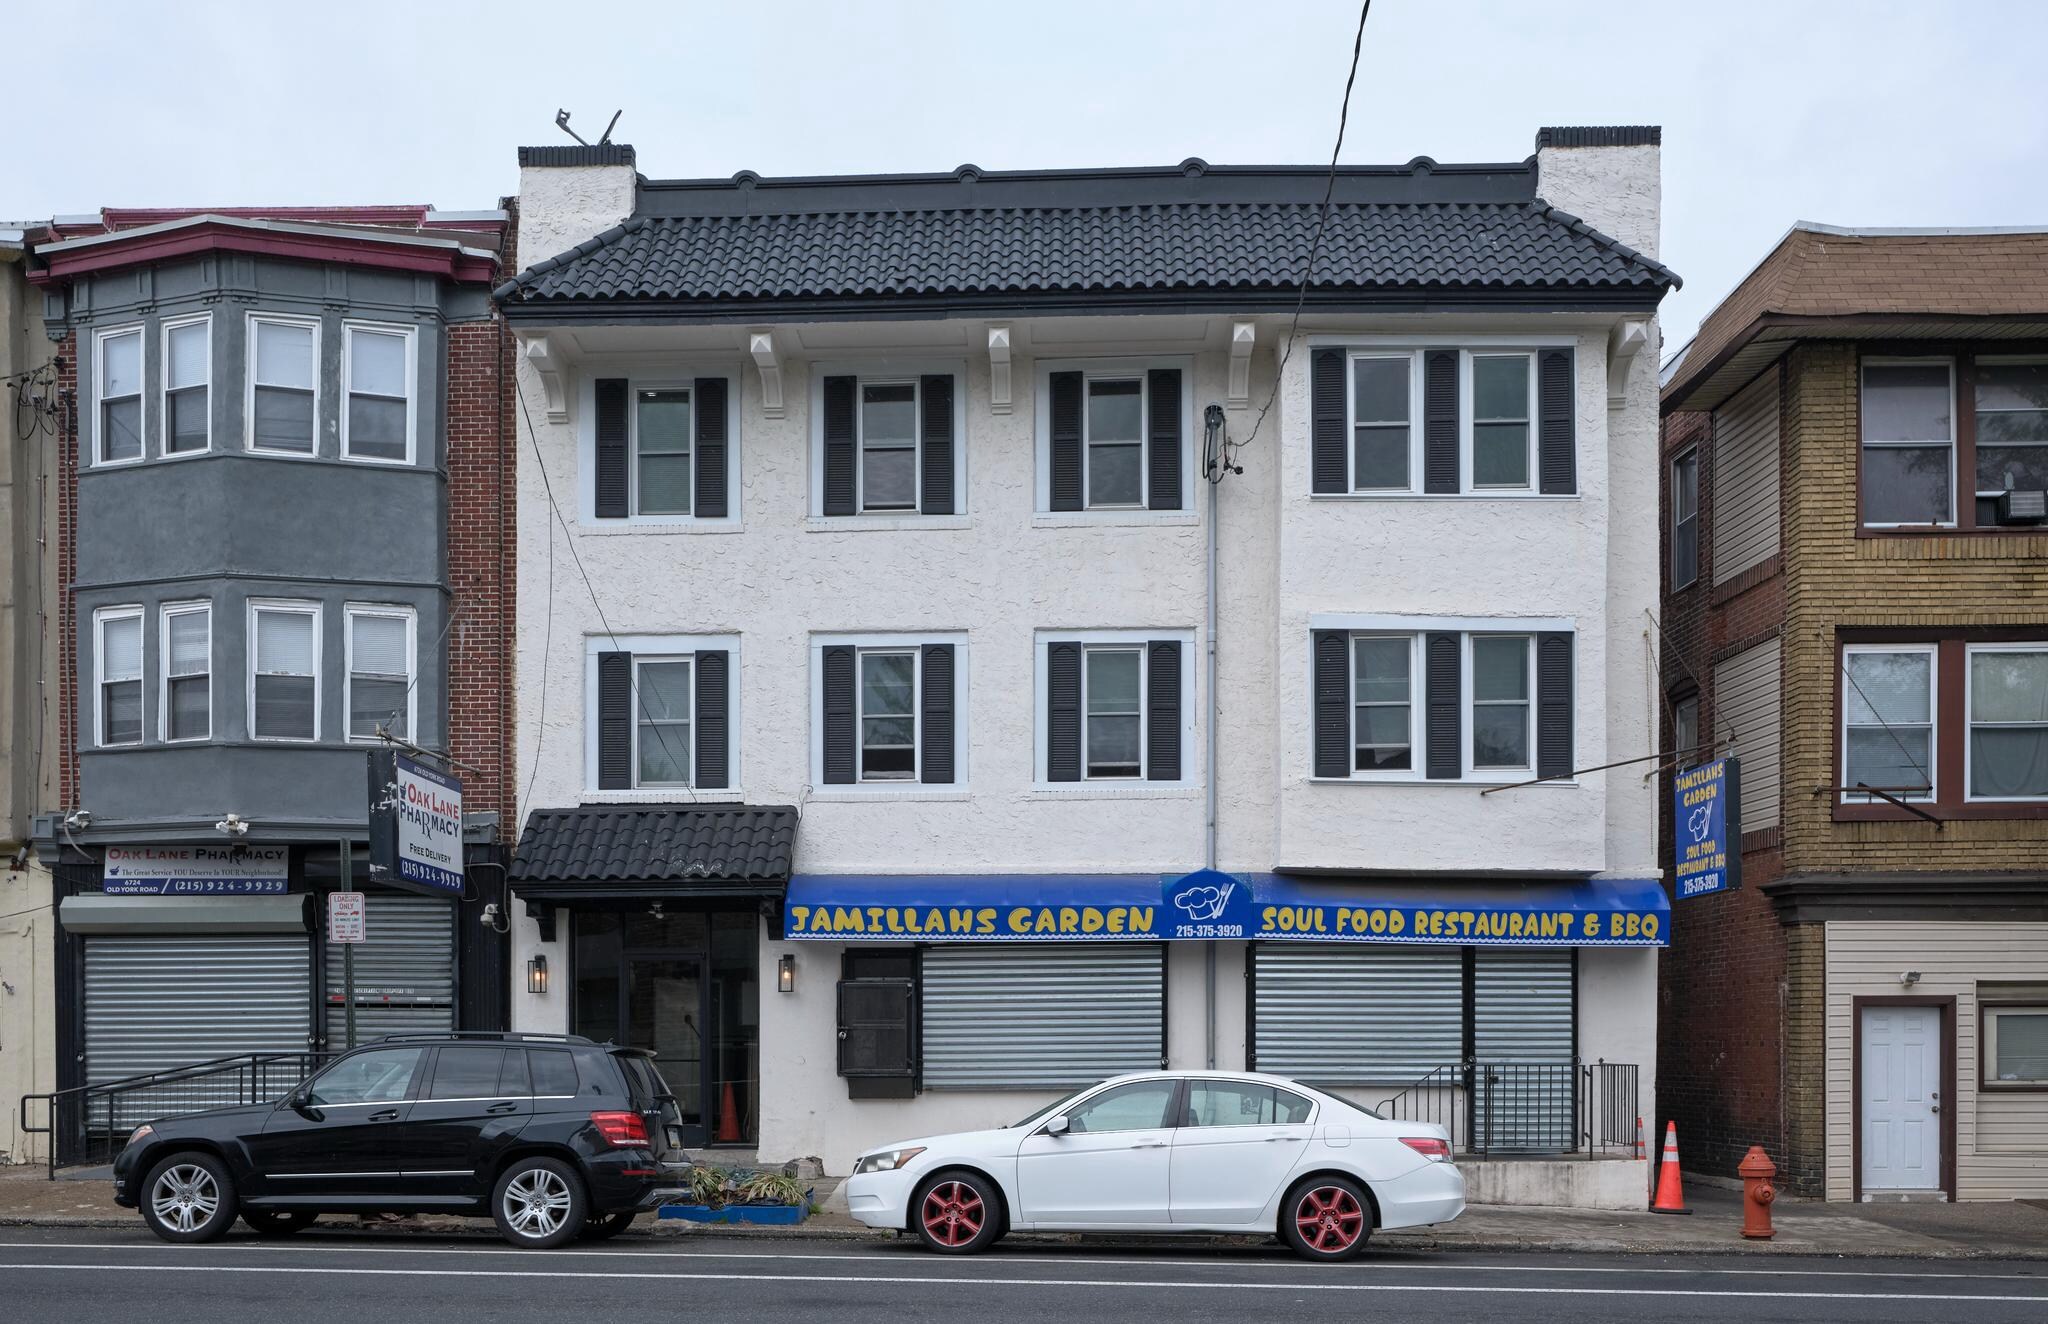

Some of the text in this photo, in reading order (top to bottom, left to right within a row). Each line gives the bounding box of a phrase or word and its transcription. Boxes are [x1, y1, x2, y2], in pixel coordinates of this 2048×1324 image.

[1676, 762, 1723, 792] JAMILLAHS
[408, 783, 459, 820] OAK LANE
[1684, 783, 1717, 807] GARDEN
[400, 800, 459, 840] PHARMACY
[109, 848, 141, 860] OAK
[146, 848, 189, 860] LANE
[409, 843, 451, 864] FREE DELIVERY
[1686, 840, 1715, 860] SOUL FOOD
[402, 860, 419, 879] (215)
[1677, 857, 1709, 877] RESTAURANT
[175, 881, 204, 892] (215)
[792, 907, 1153, 933] JAMILLAHS GARDEN
[1262, 907, 1659, 940] SOUL FOOD RESTAURANT & BBQ
[1176, 925, 1243, 937] 215-375-3920
